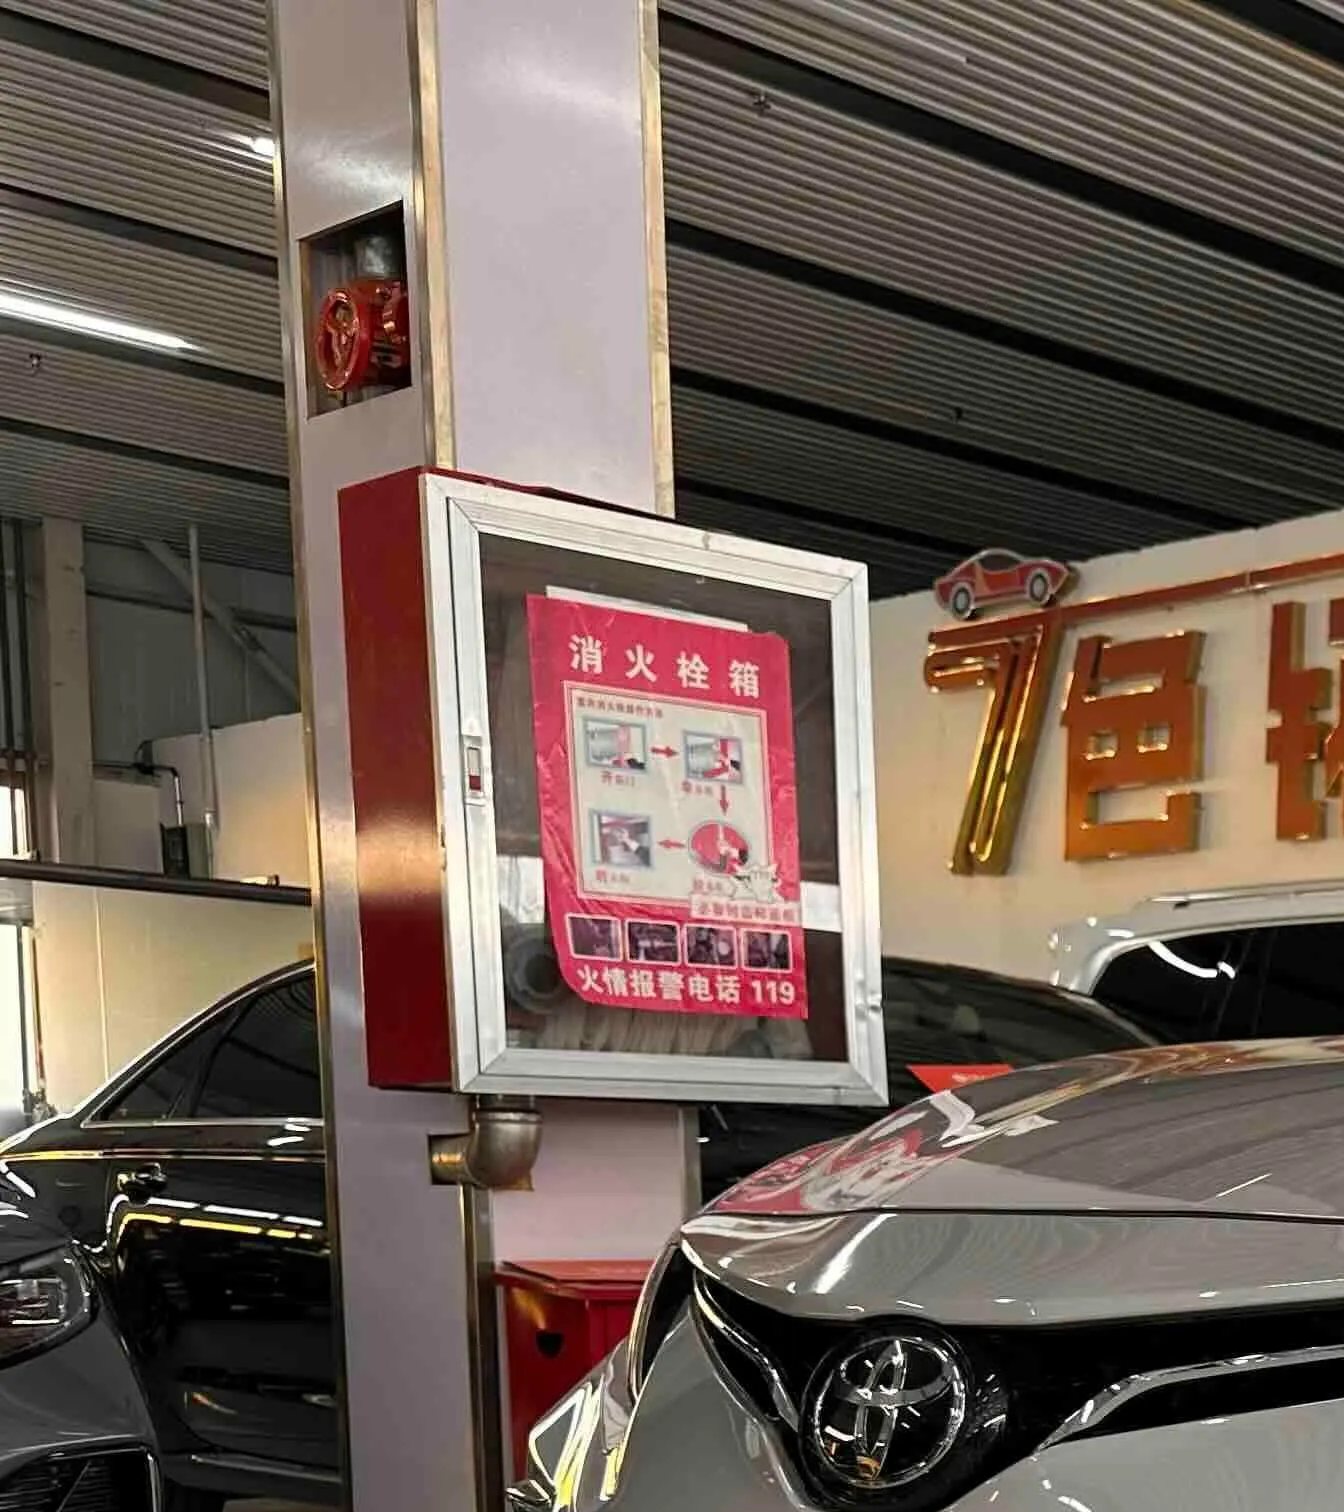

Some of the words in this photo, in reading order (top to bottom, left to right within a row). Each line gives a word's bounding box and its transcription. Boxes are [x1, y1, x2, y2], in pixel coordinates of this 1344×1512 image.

[568, 633, 761, 699] 消火栓箱
[576, 964, 742, 1005] 火情报警电话
[750, 979, 796, 1006] 119
